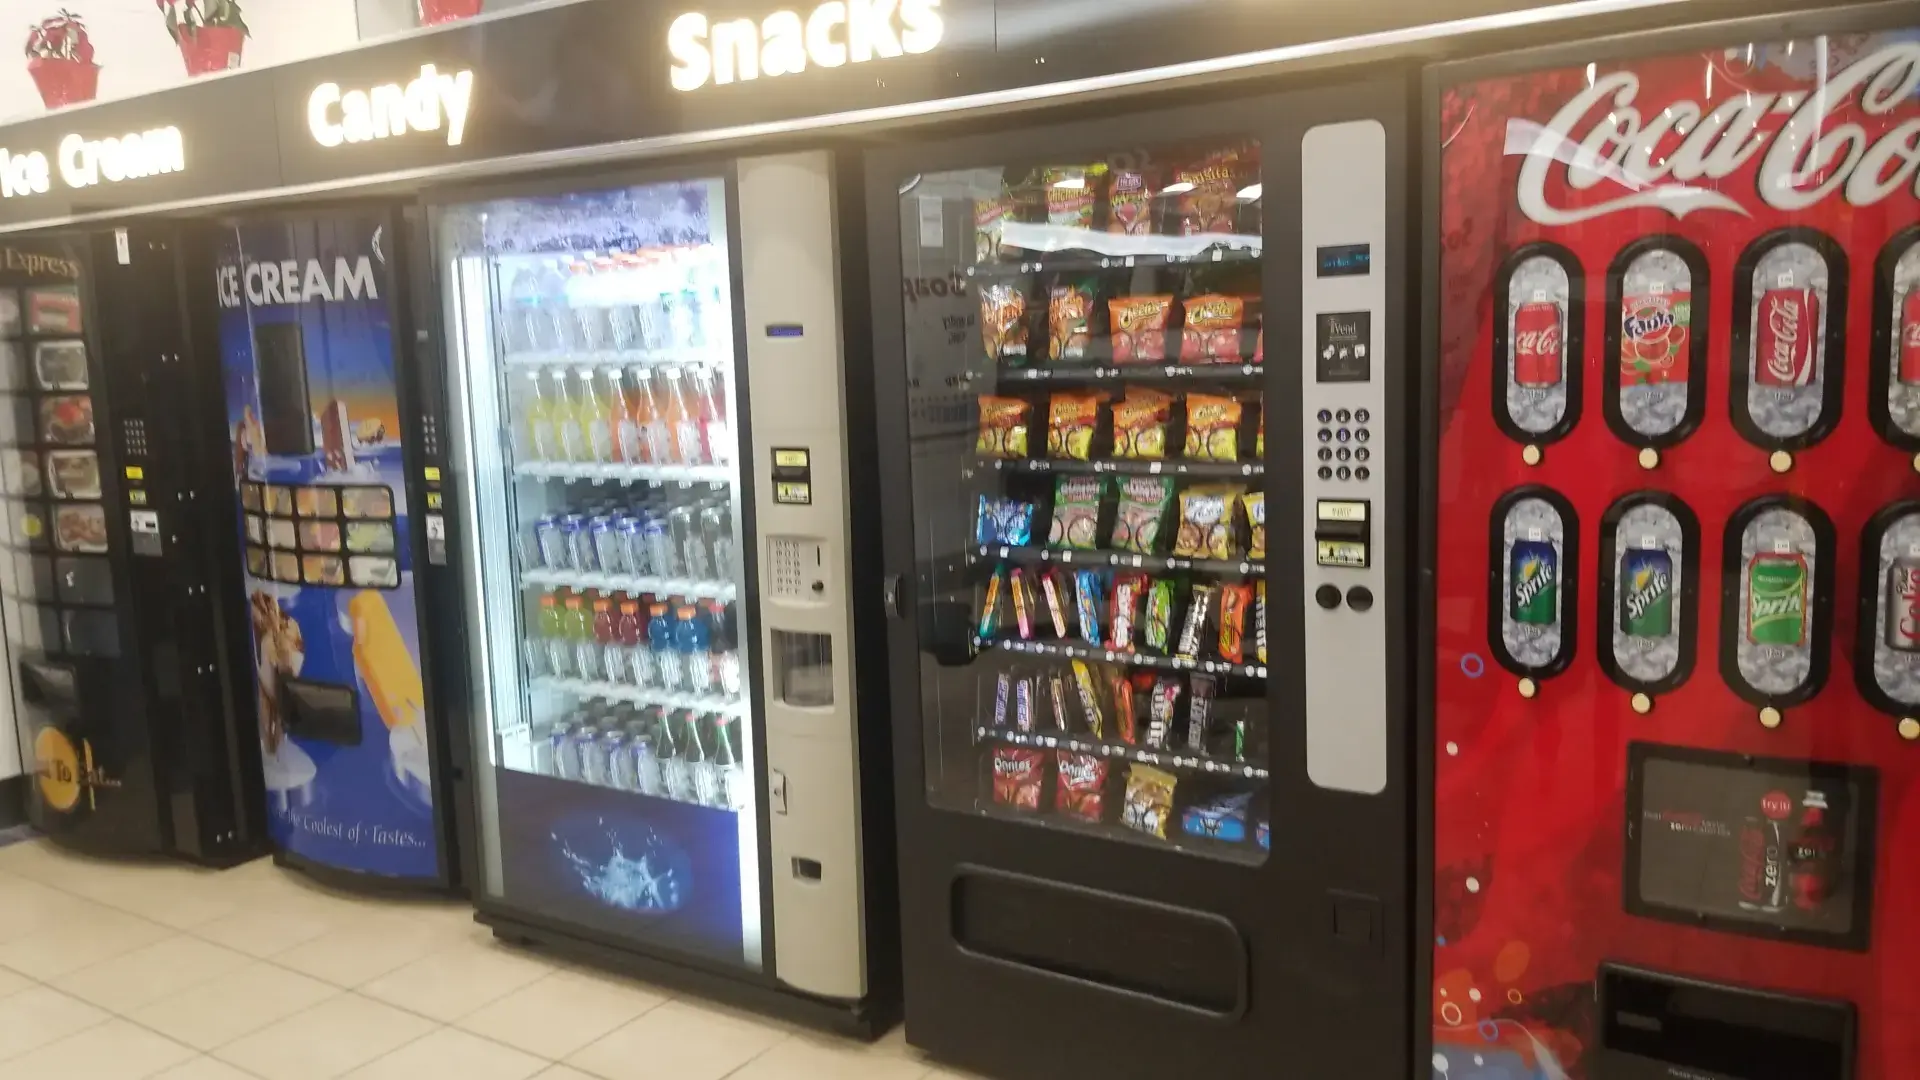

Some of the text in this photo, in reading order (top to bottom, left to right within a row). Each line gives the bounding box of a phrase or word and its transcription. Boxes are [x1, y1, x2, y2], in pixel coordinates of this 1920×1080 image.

[668, 0, 944, 92] Snacks
[307, 63, 473, 147] Candy
[0, 125, 185, 198] Ice Cream
[5, 247, 80, 279] Express
[215, 255, 379, 308] ICE CREAM
[1623, 311, 1675, 338] Fanta
[1515, 563, 1553, 608] Sprite
[1626, 570, 1668, 621] Sprite
[1765, 844, 1778, 888] zero
